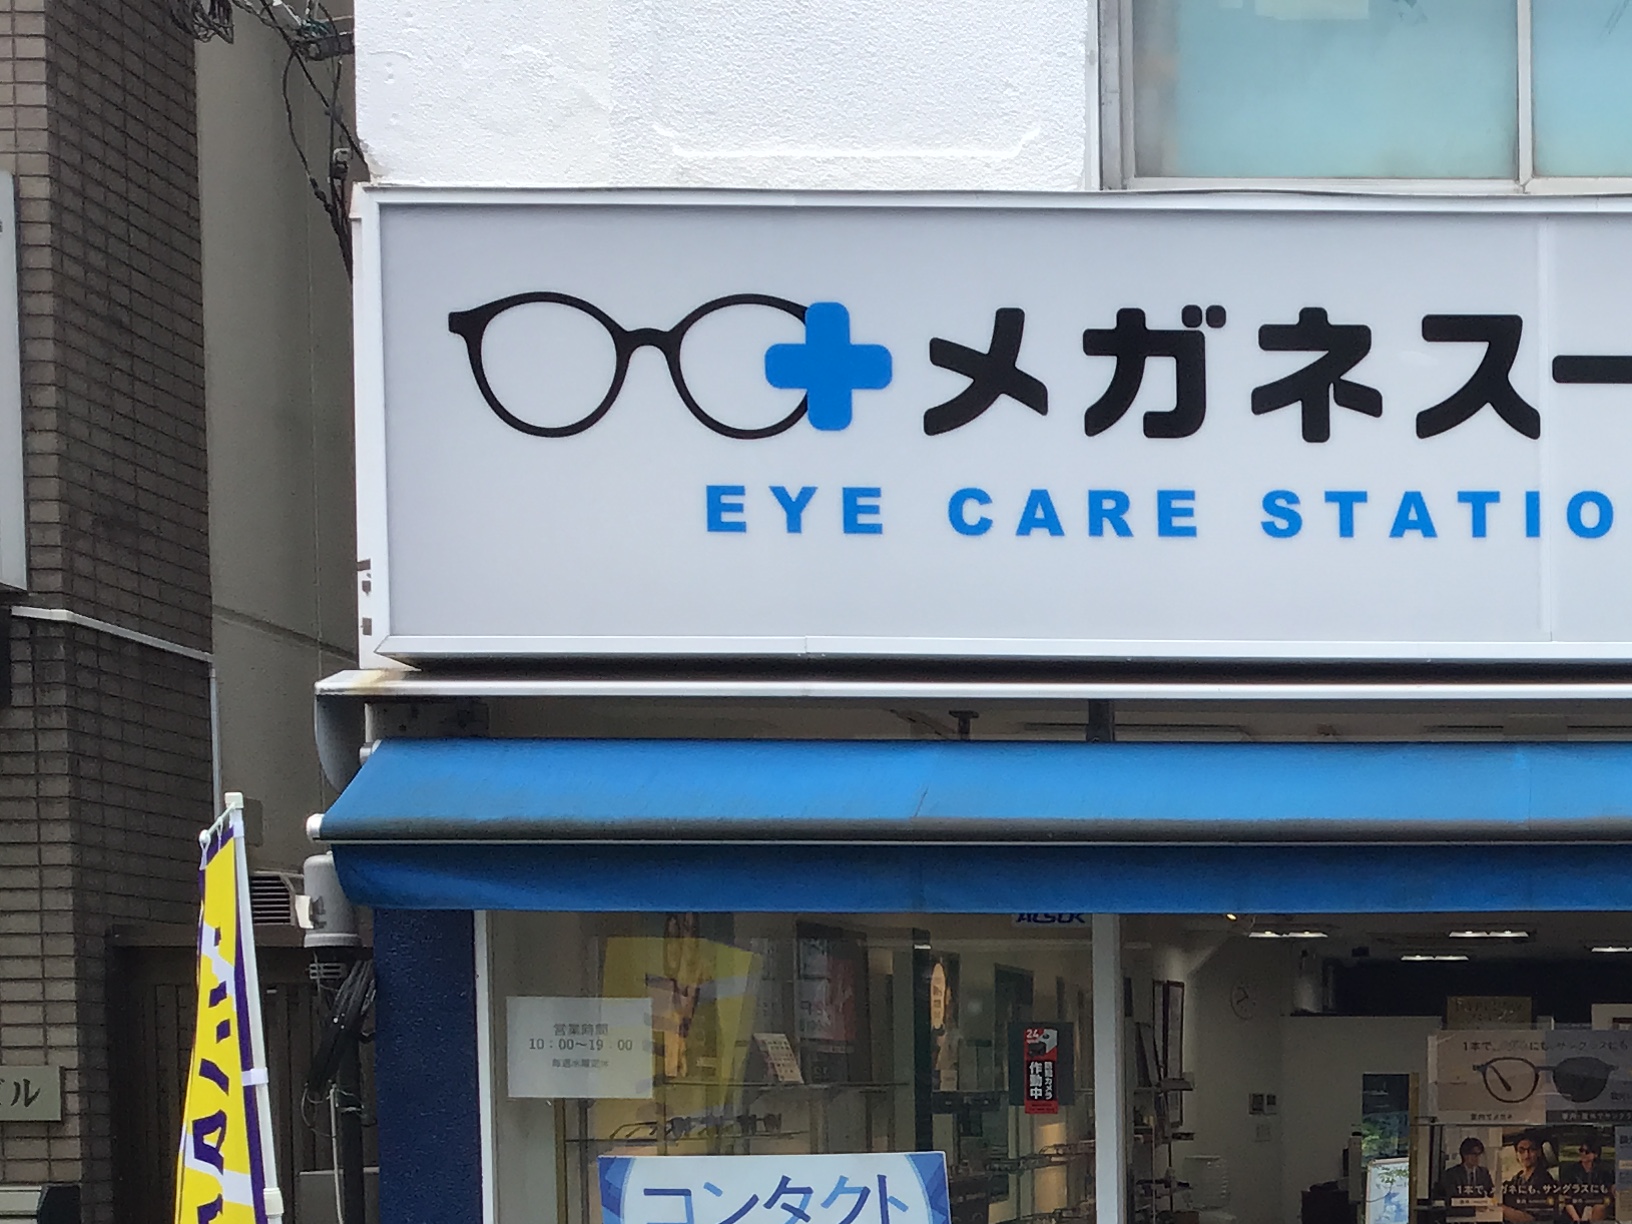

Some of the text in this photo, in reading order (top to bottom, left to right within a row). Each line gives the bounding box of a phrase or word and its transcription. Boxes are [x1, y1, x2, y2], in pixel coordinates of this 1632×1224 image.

[706, 484, 884, 533] EYE
[948, 486, 1199, 538] CARE
[553, 1024, 608, 1035] 営業時間
[1029, 1061, 1042, 1100] 作動中
